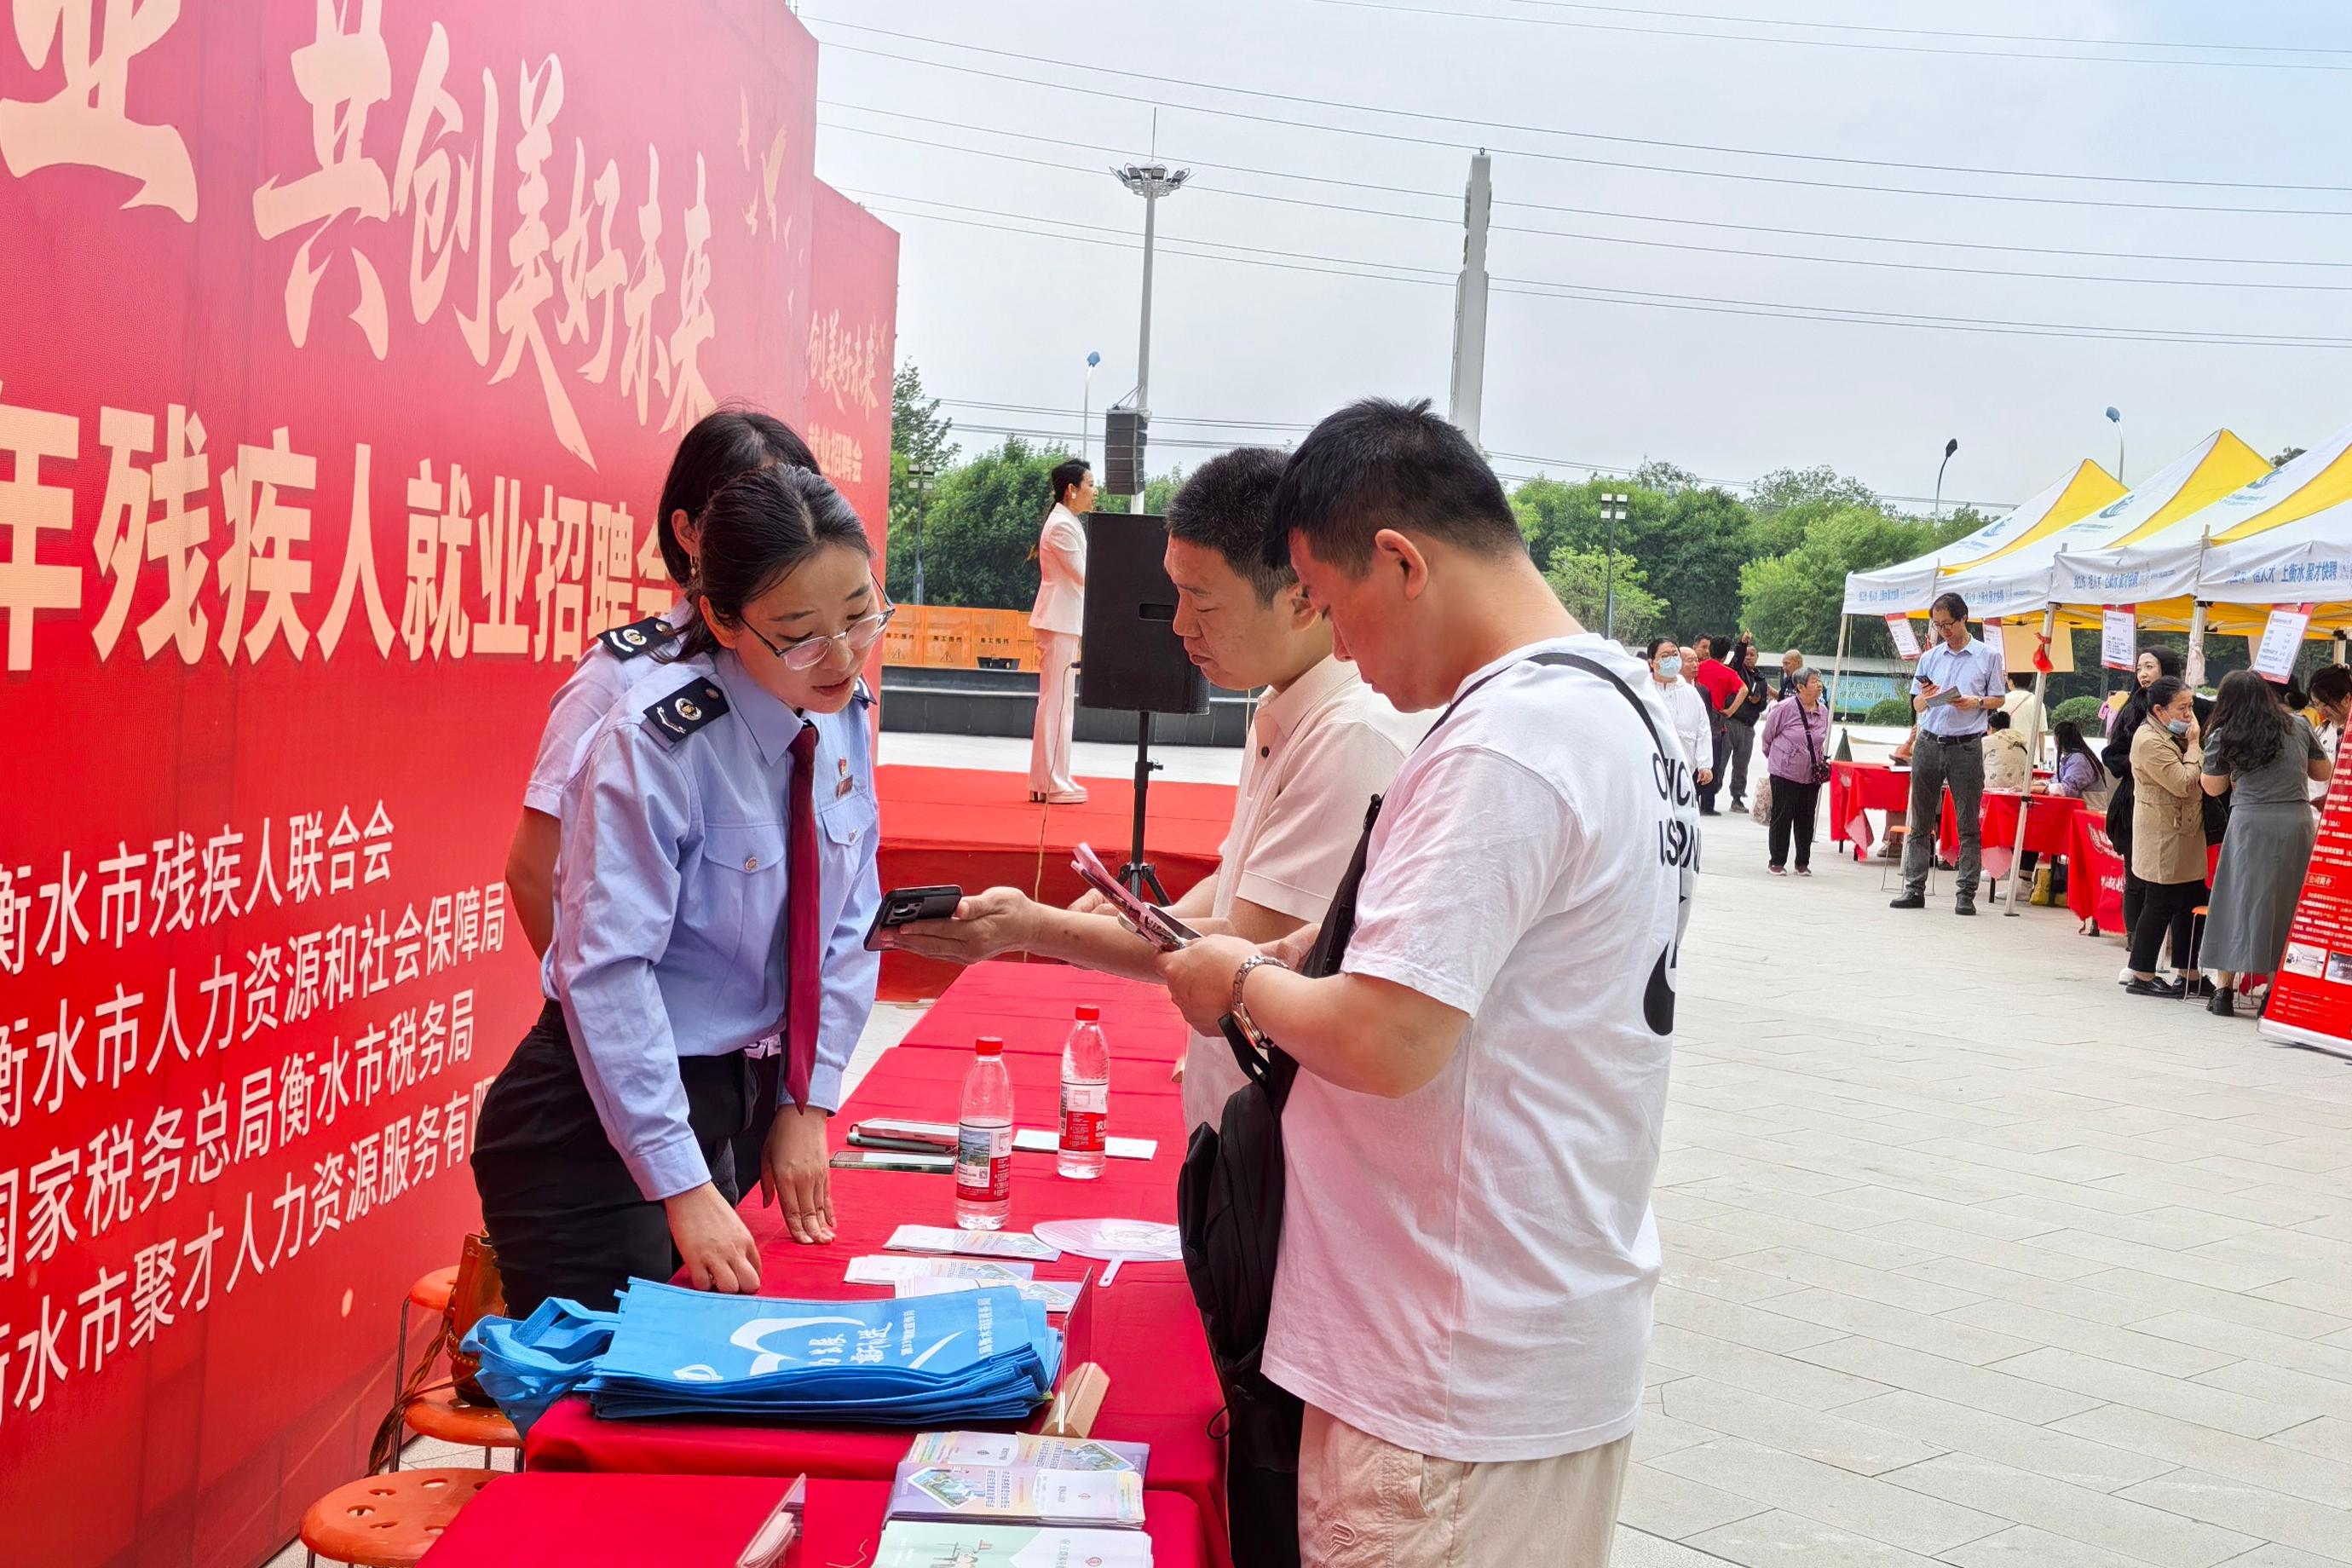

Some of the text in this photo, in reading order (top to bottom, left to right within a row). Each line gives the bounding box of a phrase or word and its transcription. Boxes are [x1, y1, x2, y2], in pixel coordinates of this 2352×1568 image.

[253, 0, 718, 474] 共创美好未来
[805, 308, 879, 422] 创美好未来
[0, 1075, 497, 1427] 水市聚才人力资源服务有
